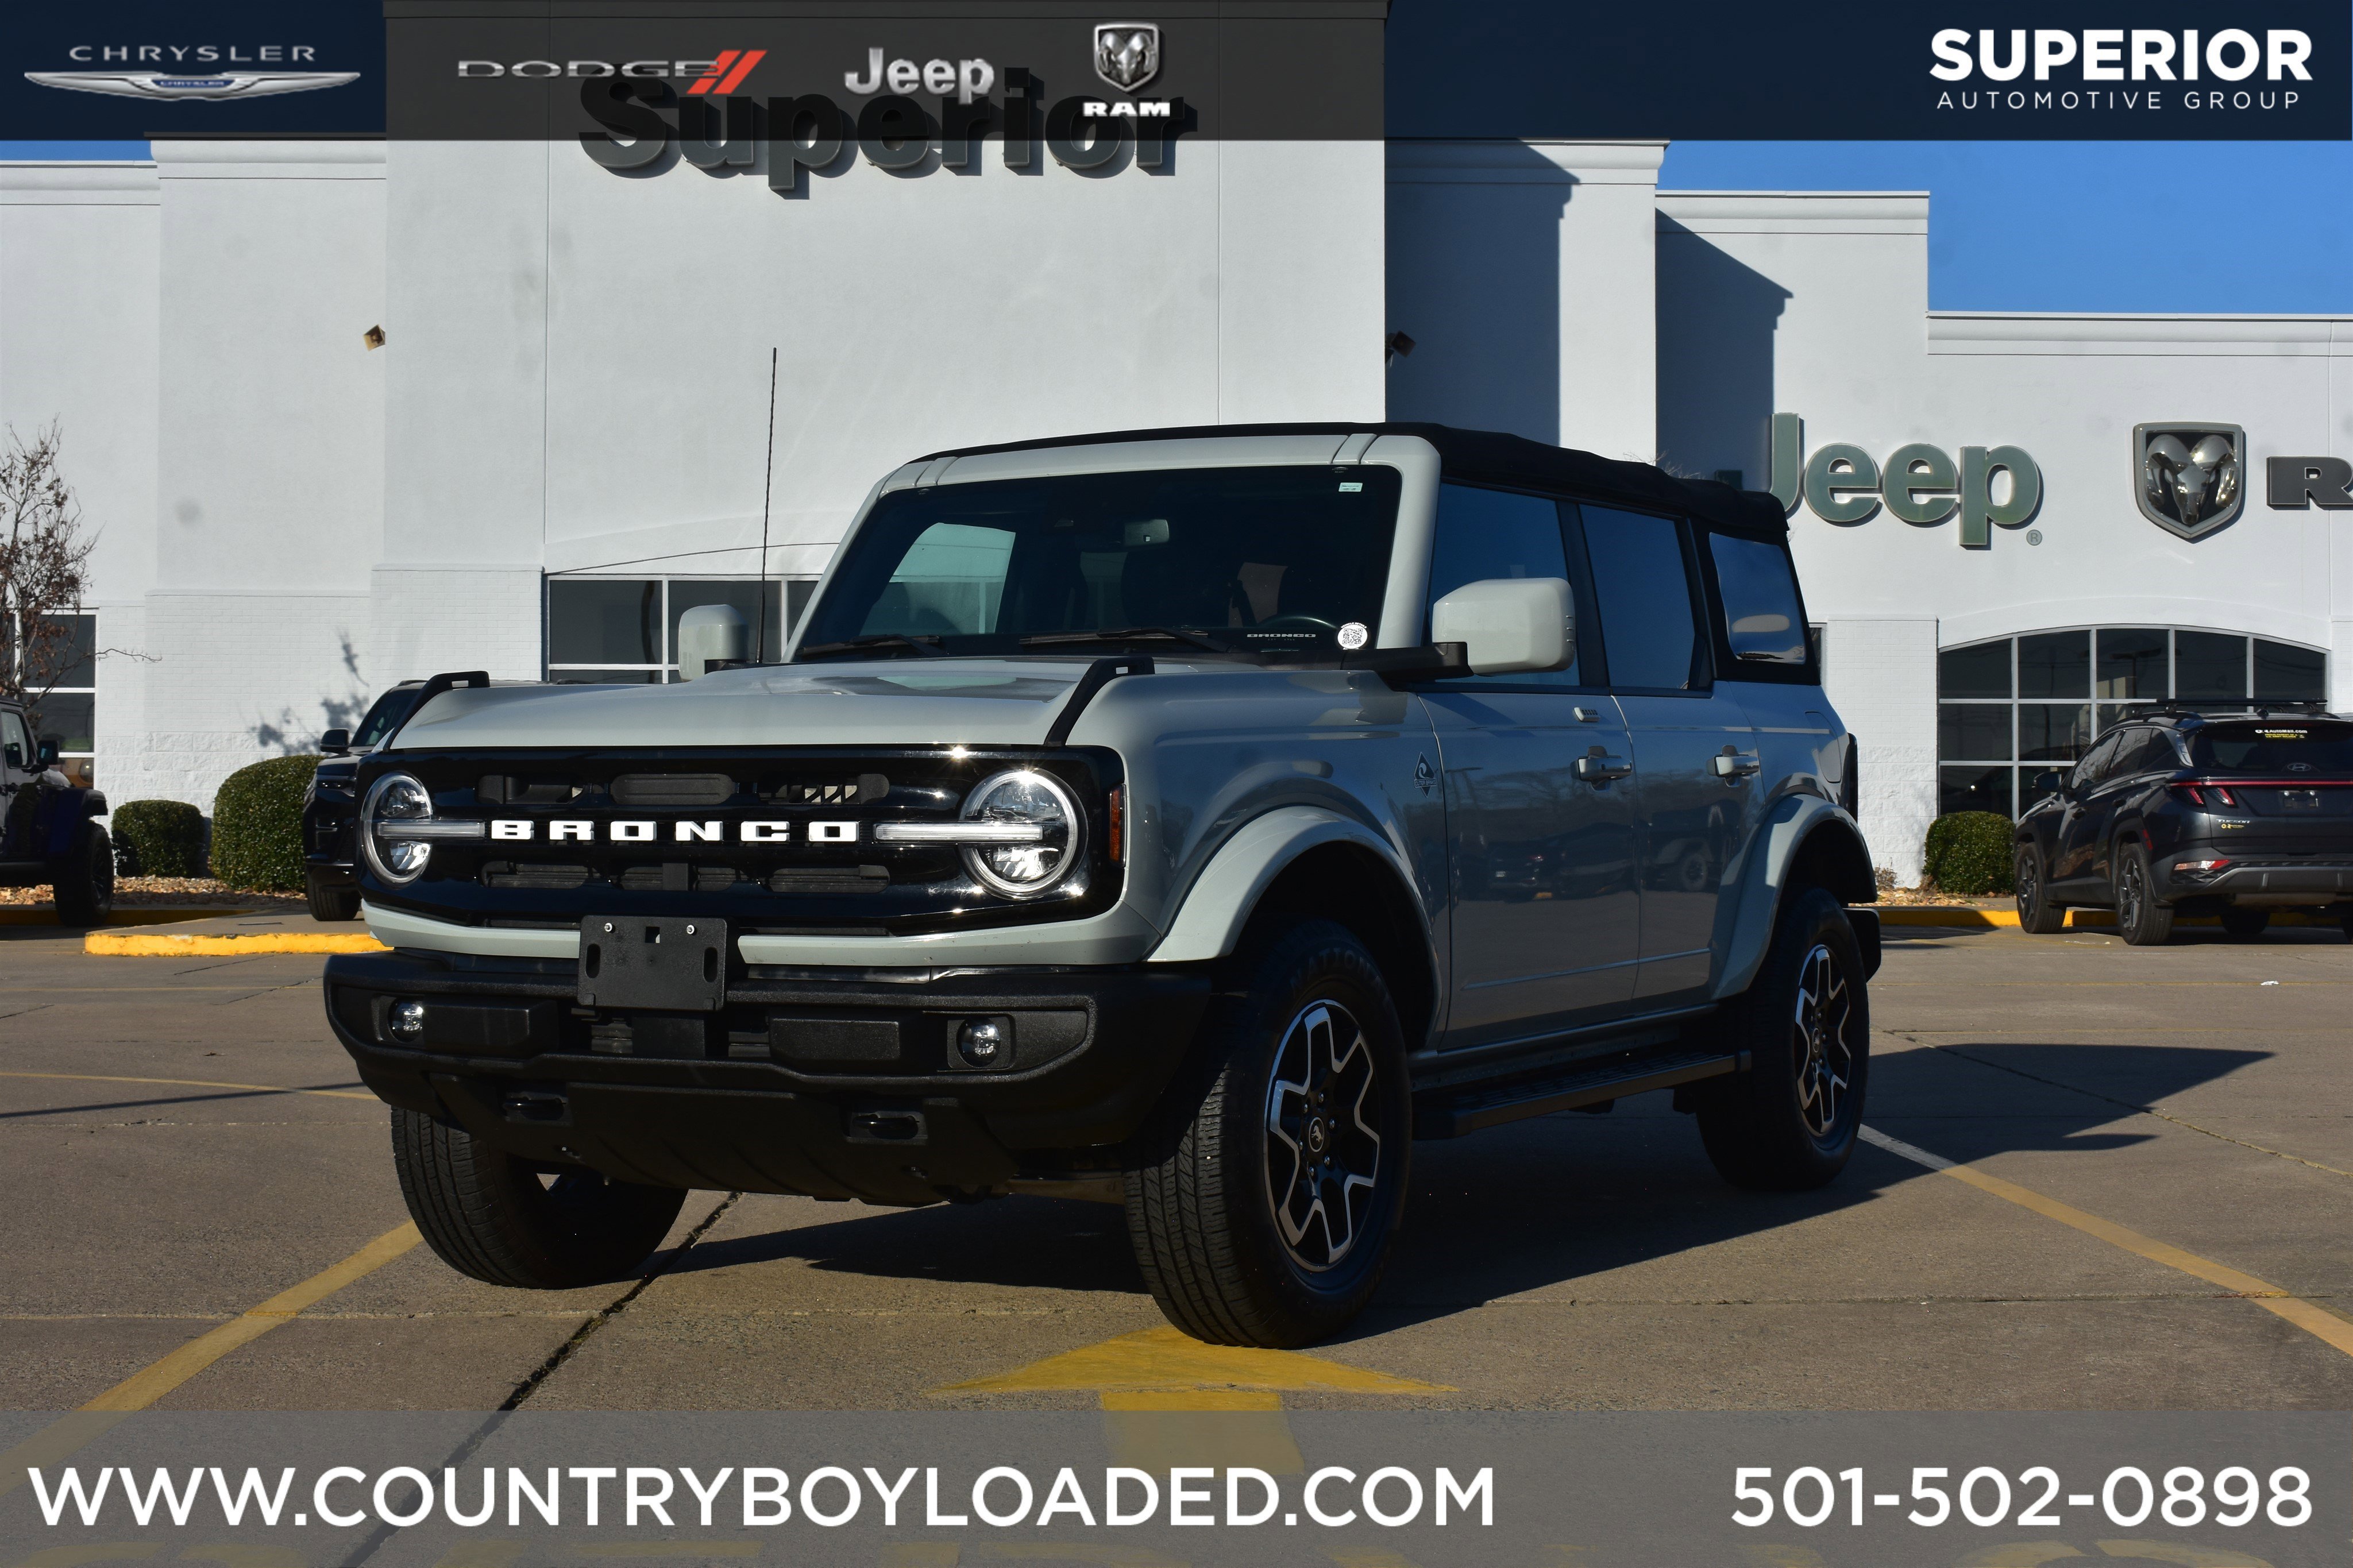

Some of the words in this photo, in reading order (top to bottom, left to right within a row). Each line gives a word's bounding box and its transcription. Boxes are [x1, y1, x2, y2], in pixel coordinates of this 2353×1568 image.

[578, 65, 1186, 191] Superior
[1715, 412, 2040, 546] Jeep
[491, 820, 859, 841] BRONCO
